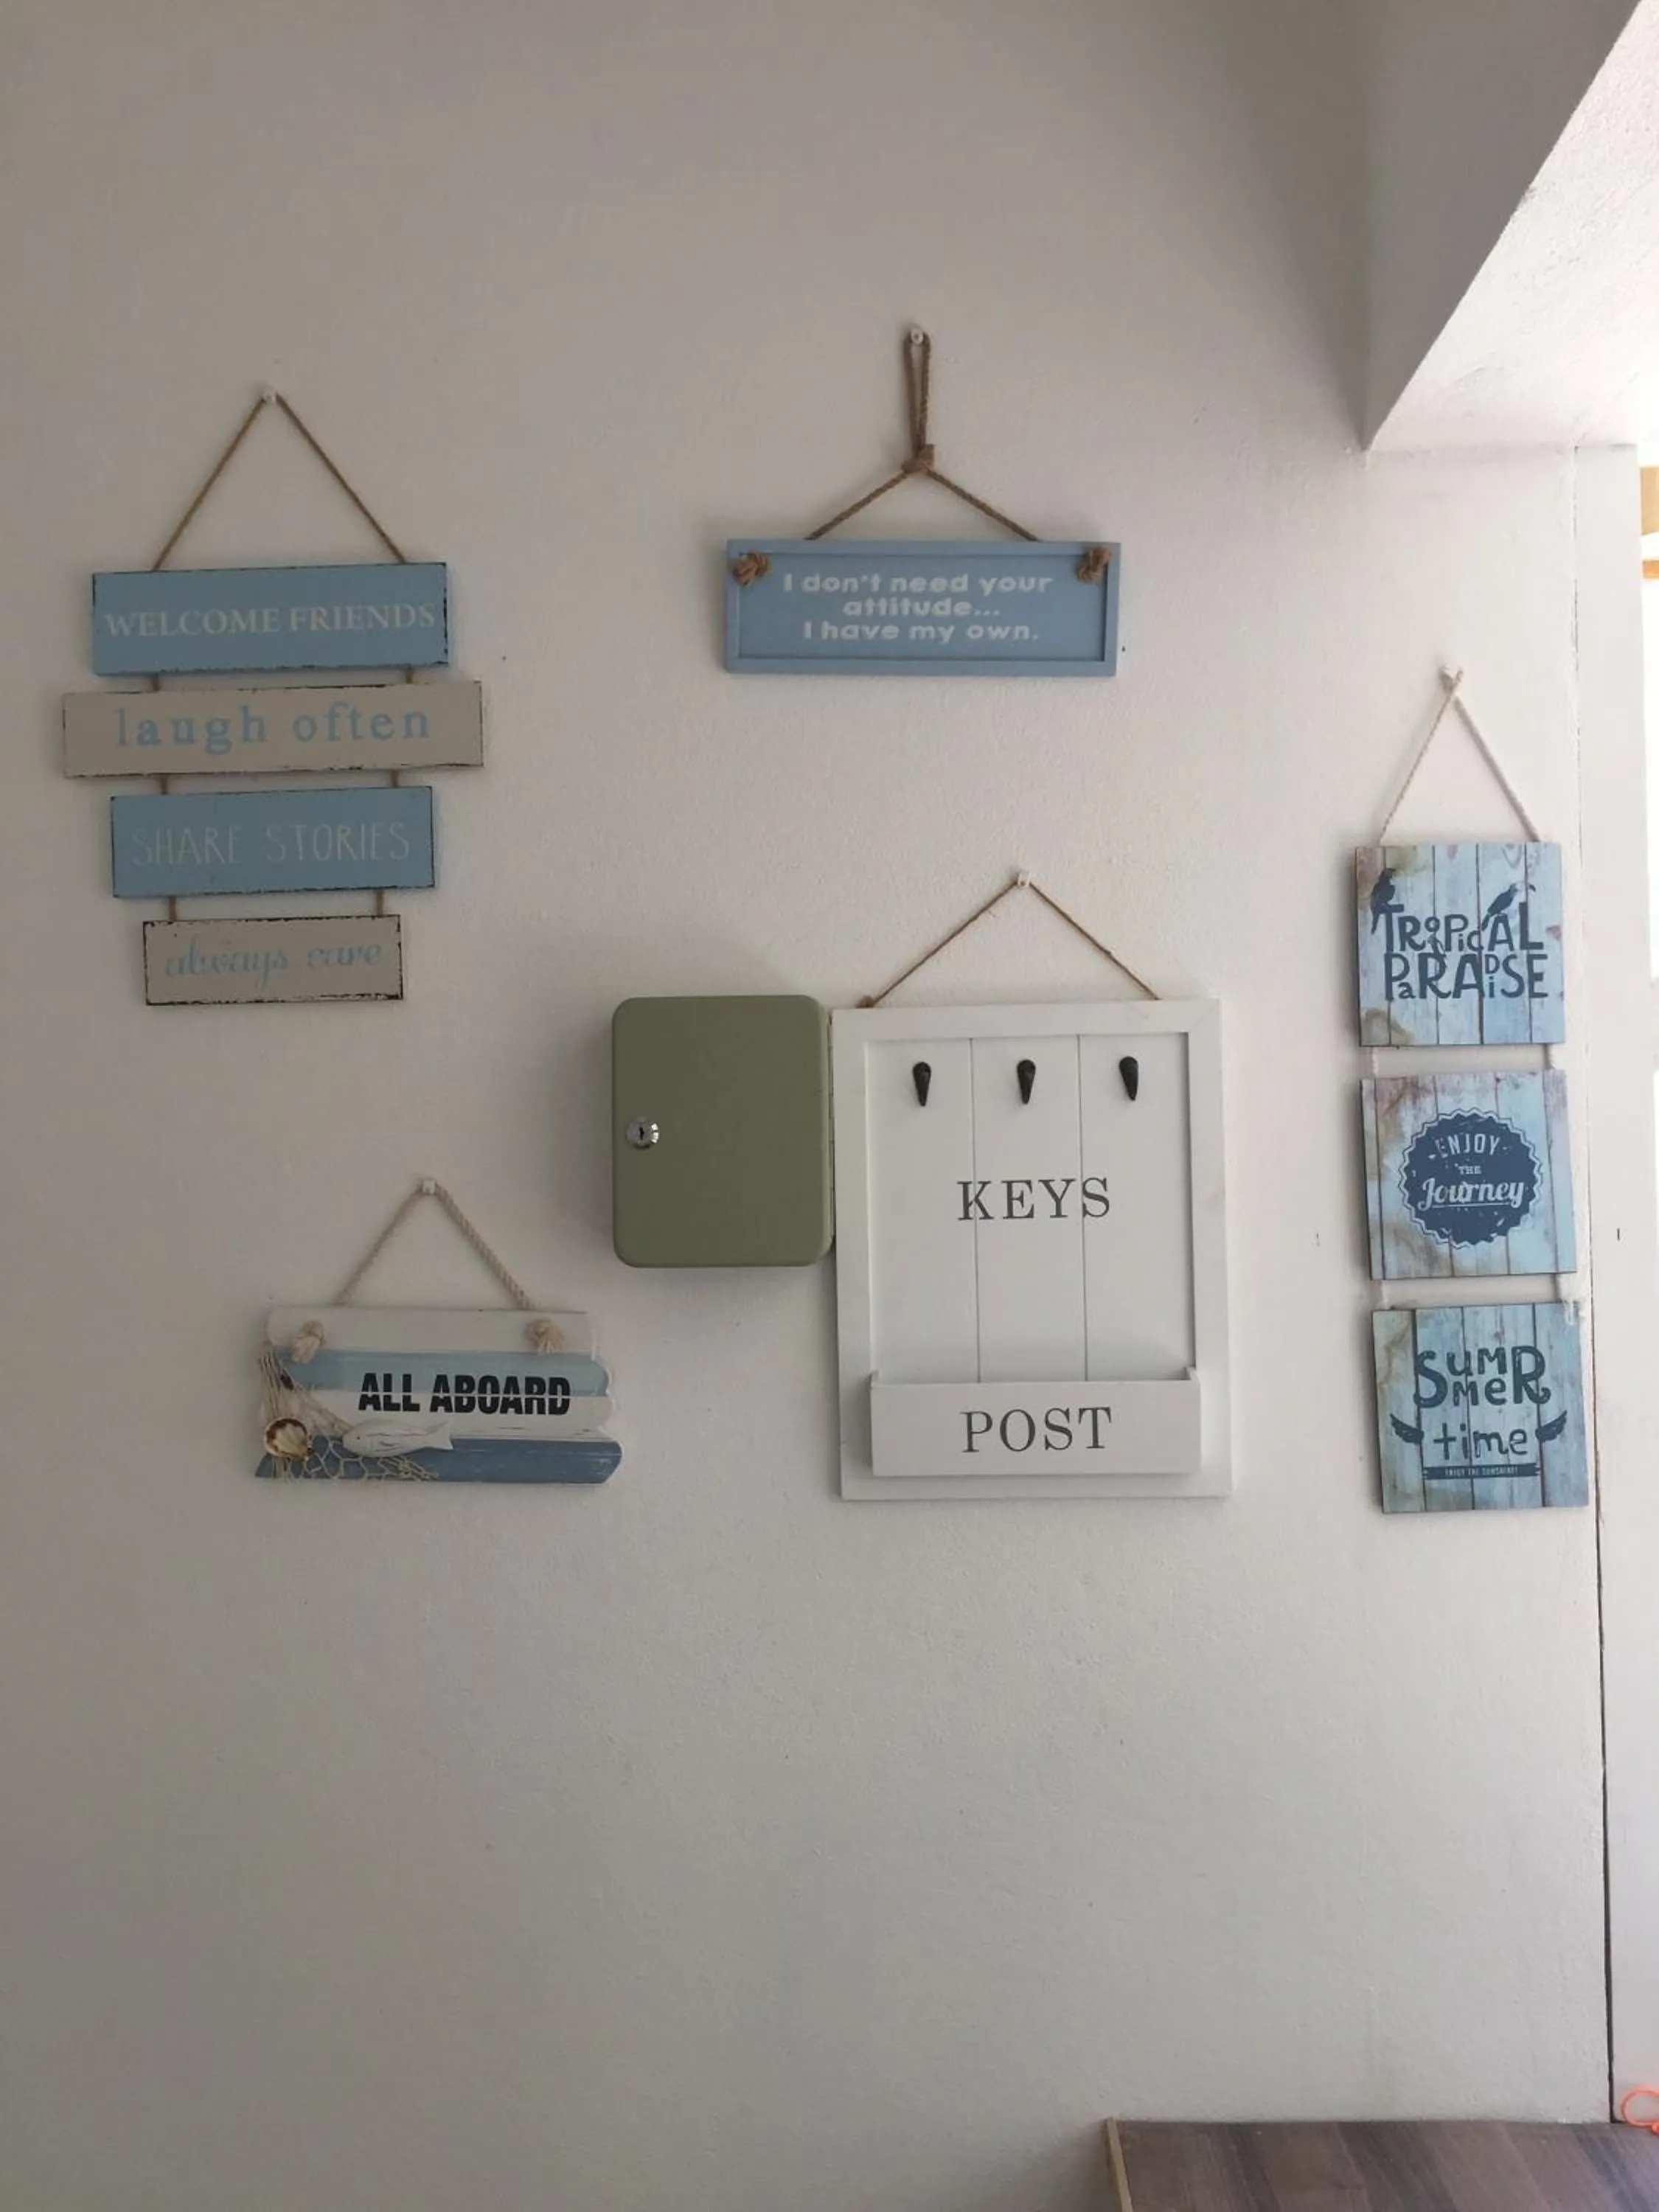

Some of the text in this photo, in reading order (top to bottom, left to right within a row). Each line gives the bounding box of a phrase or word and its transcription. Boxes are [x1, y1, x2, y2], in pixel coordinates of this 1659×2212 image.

[784, 572, 1053, 596] I don't need your
[105, 602, 437, 637] WELCOME FRIENDS
[843, 597, 999, 616] attitude...
[804, 622, 1039, 644] I have my own.
[116, 701, 431, 755] laugh often
[131, 820, 410, 866] SHARE STORIES
[164, 933, 382, 990] always care
[1435, 1133, 1501, 1158] ENJOY
[1458, 1165, 1482, 1175] THE
[957, 1177, 1110, 1221] KEYS
[1417, 1178, 1524, 1211] Journey
[358, 1371, 571, 1416] ALL ABOARD
[961, 1407, 1112, 1453] POST
[1433, 1422, 1528, 1460] time
